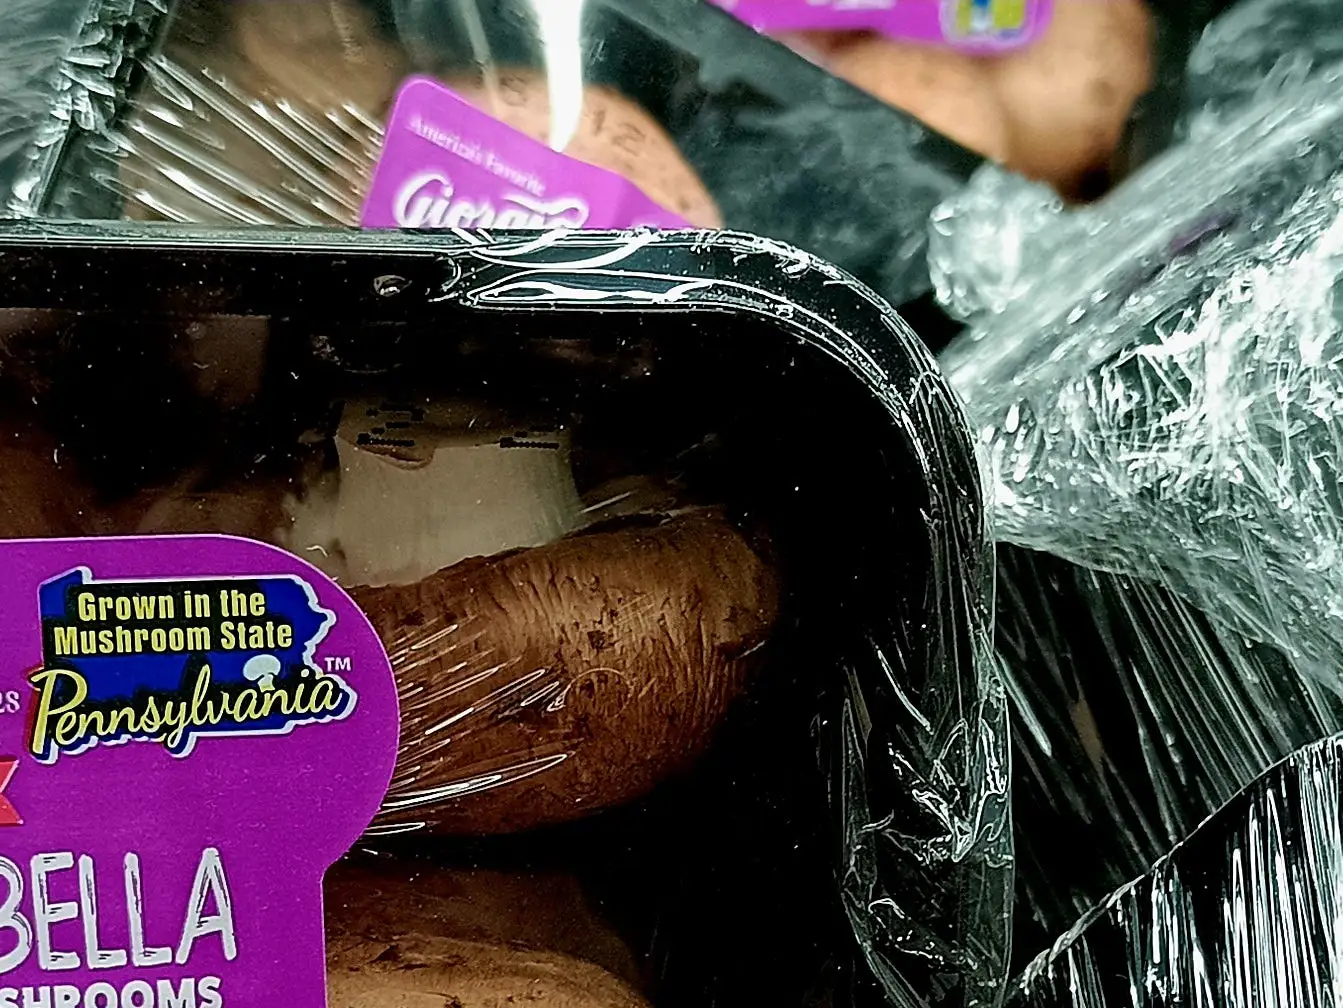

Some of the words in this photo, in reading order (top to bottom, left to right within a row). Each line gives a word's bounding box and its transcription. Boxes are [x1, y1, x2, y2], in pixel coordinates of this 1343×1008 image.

[78, 593, 174, 621] Grown
[184, 591, 211, 618] in
[220, 590, 265, 616] the
[54, 626, 211, 655] Mushroom
[221, 622, 293, 650] State
[30, 664, 343, 756] Pennsylvania
